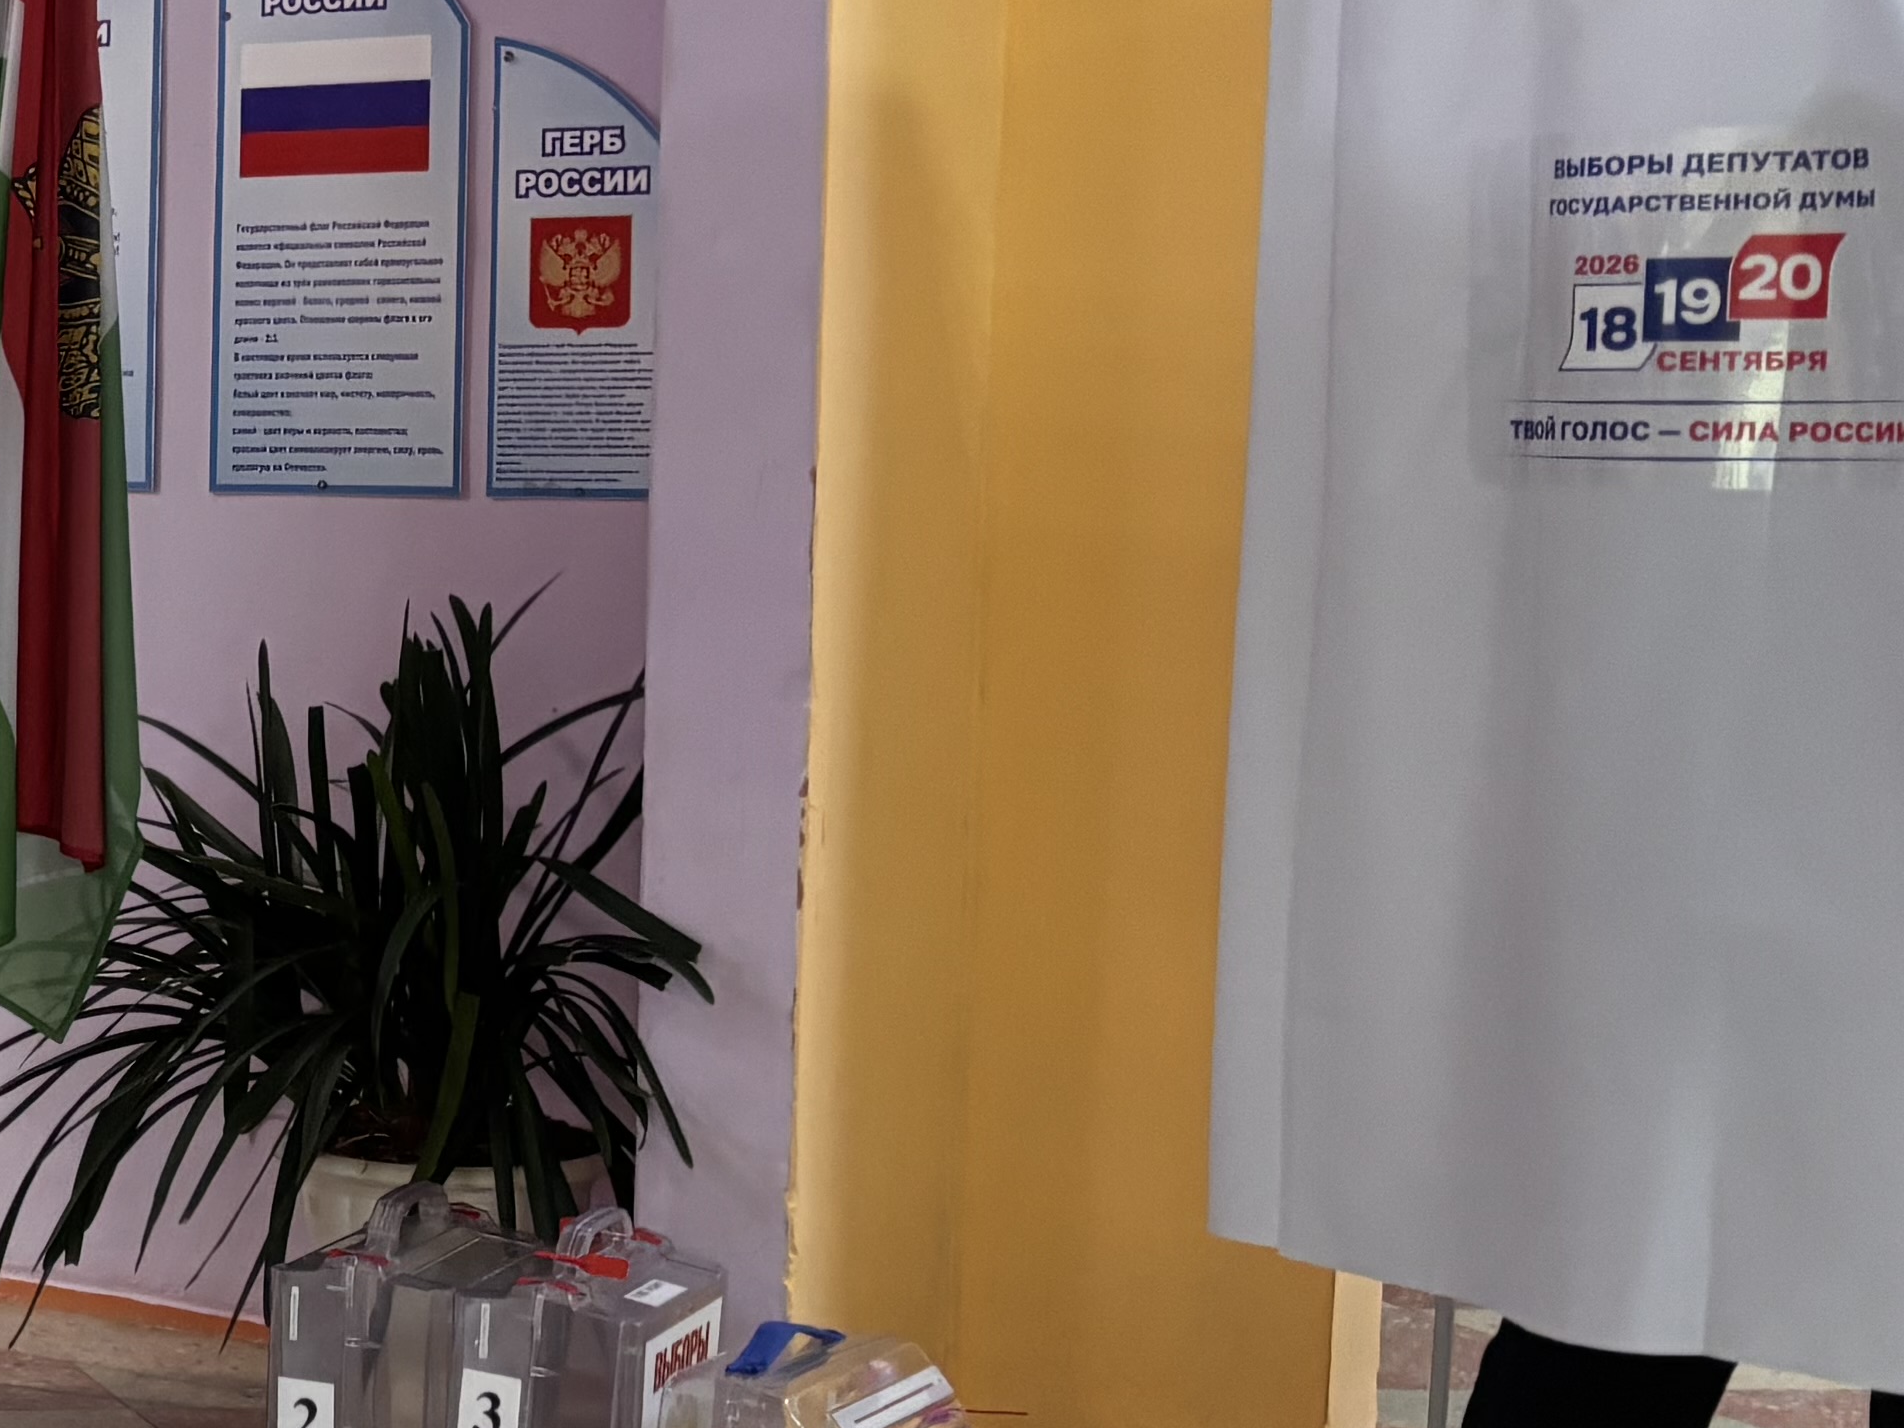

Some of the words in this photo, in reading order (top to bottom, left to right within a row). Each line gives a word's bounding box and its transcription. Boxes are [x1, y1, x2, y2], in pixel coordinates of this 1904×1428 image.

[542, 125, 625, 157] ГЕРБ
[1554, 154, 1673, 179] ВЫБОРЫ
[1682, 148, 1869, 176] ДЕПУТАТОВ
[515, 165, 651, 199] РОССИИ
[1549, 189, 1791, 217] ГОСУДАРСТВЕННОЙ
[1798, 189, 1876, 211] ДУМЫ
[1575, 255, 1639, 275] 2026
[1580, 308, 1636, 352] 18
[1655, 279, 1721, 325] 19
[1739, 254, 1823, 301] 20
[1657, 350, 1827, 372] СЕНТЯБРЯ
[1511, 416, 1557, 441] ТВОЙ
[1561, 421, 1650, 442] ГОЛОС
[1689, 421, 1779, 443] СИЛА
[653, 1321, 710, 1394] ВЫБОРЫ
